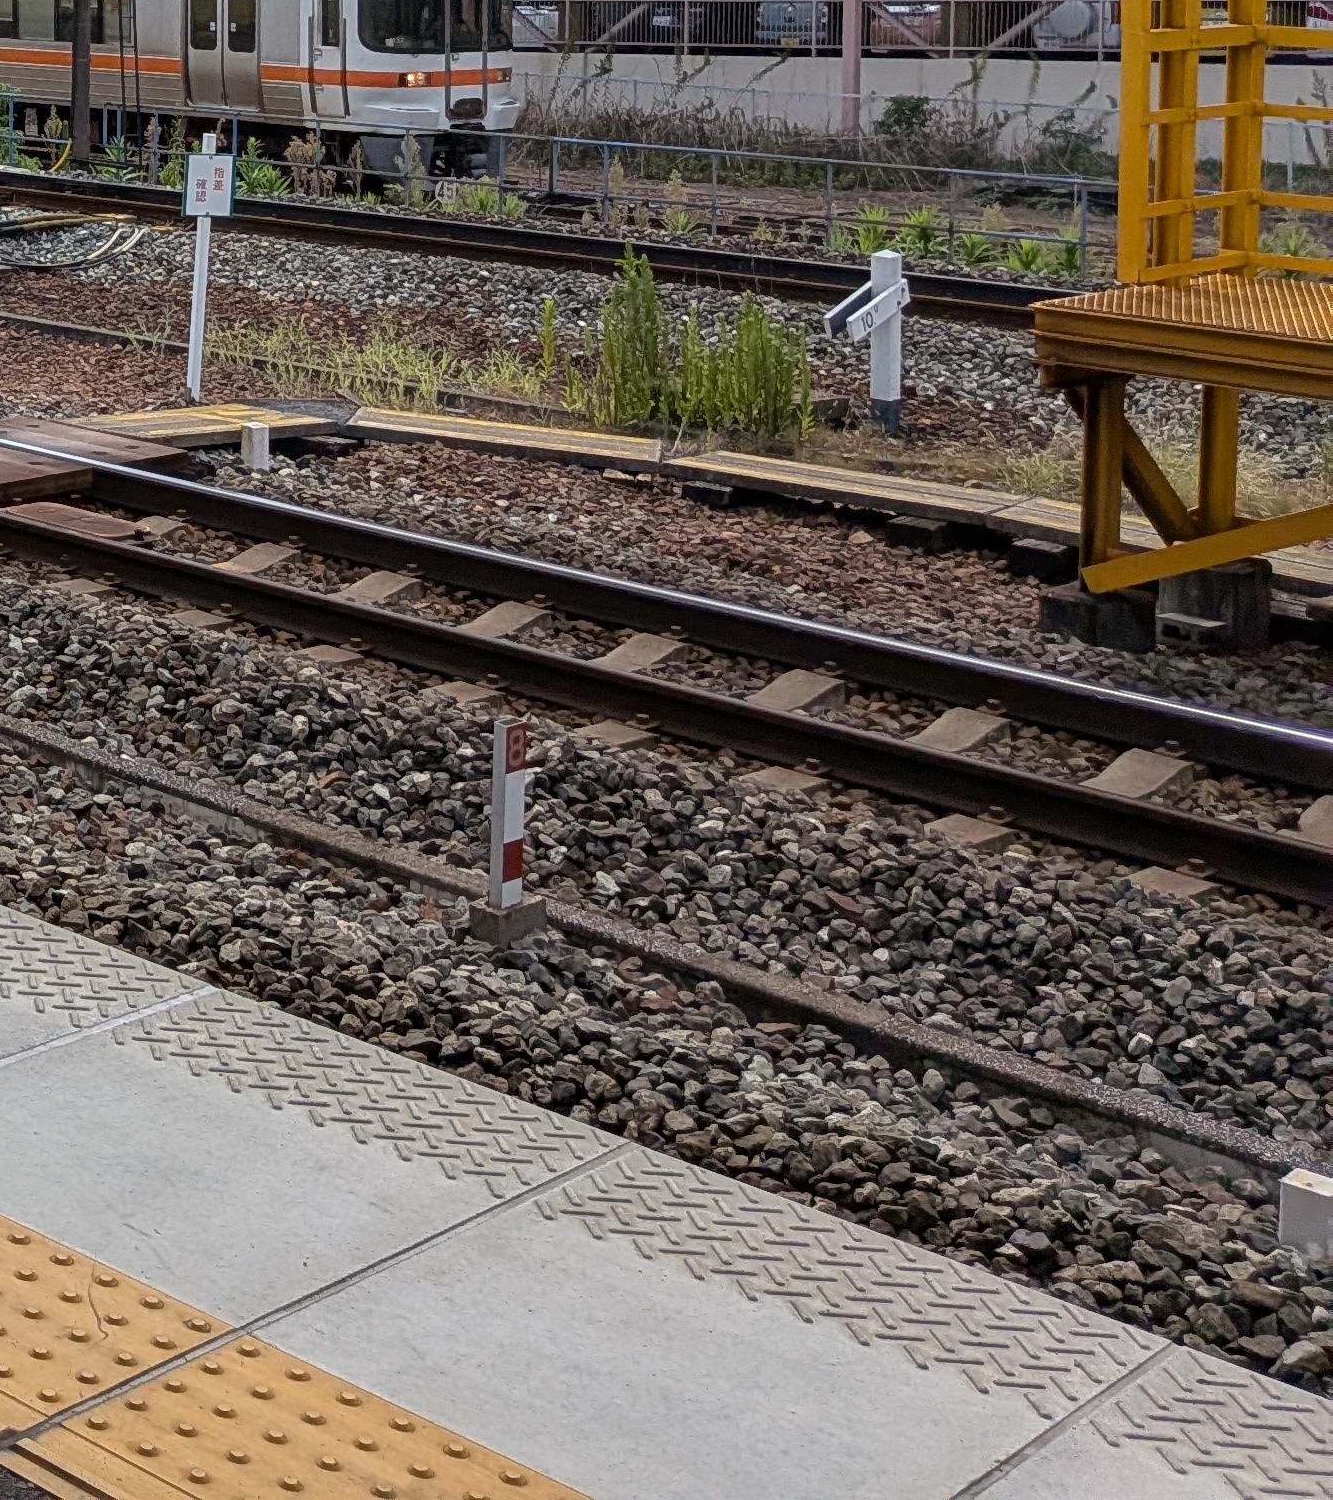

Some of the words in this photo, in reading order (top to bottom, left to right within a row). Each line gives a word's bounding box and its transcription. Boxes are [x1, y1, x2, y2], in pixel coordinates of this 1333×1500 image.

[195, 178, 207, 202] 確認
[213, 166, 224, 191] 指差
[509, 728, 525, 767] 8
